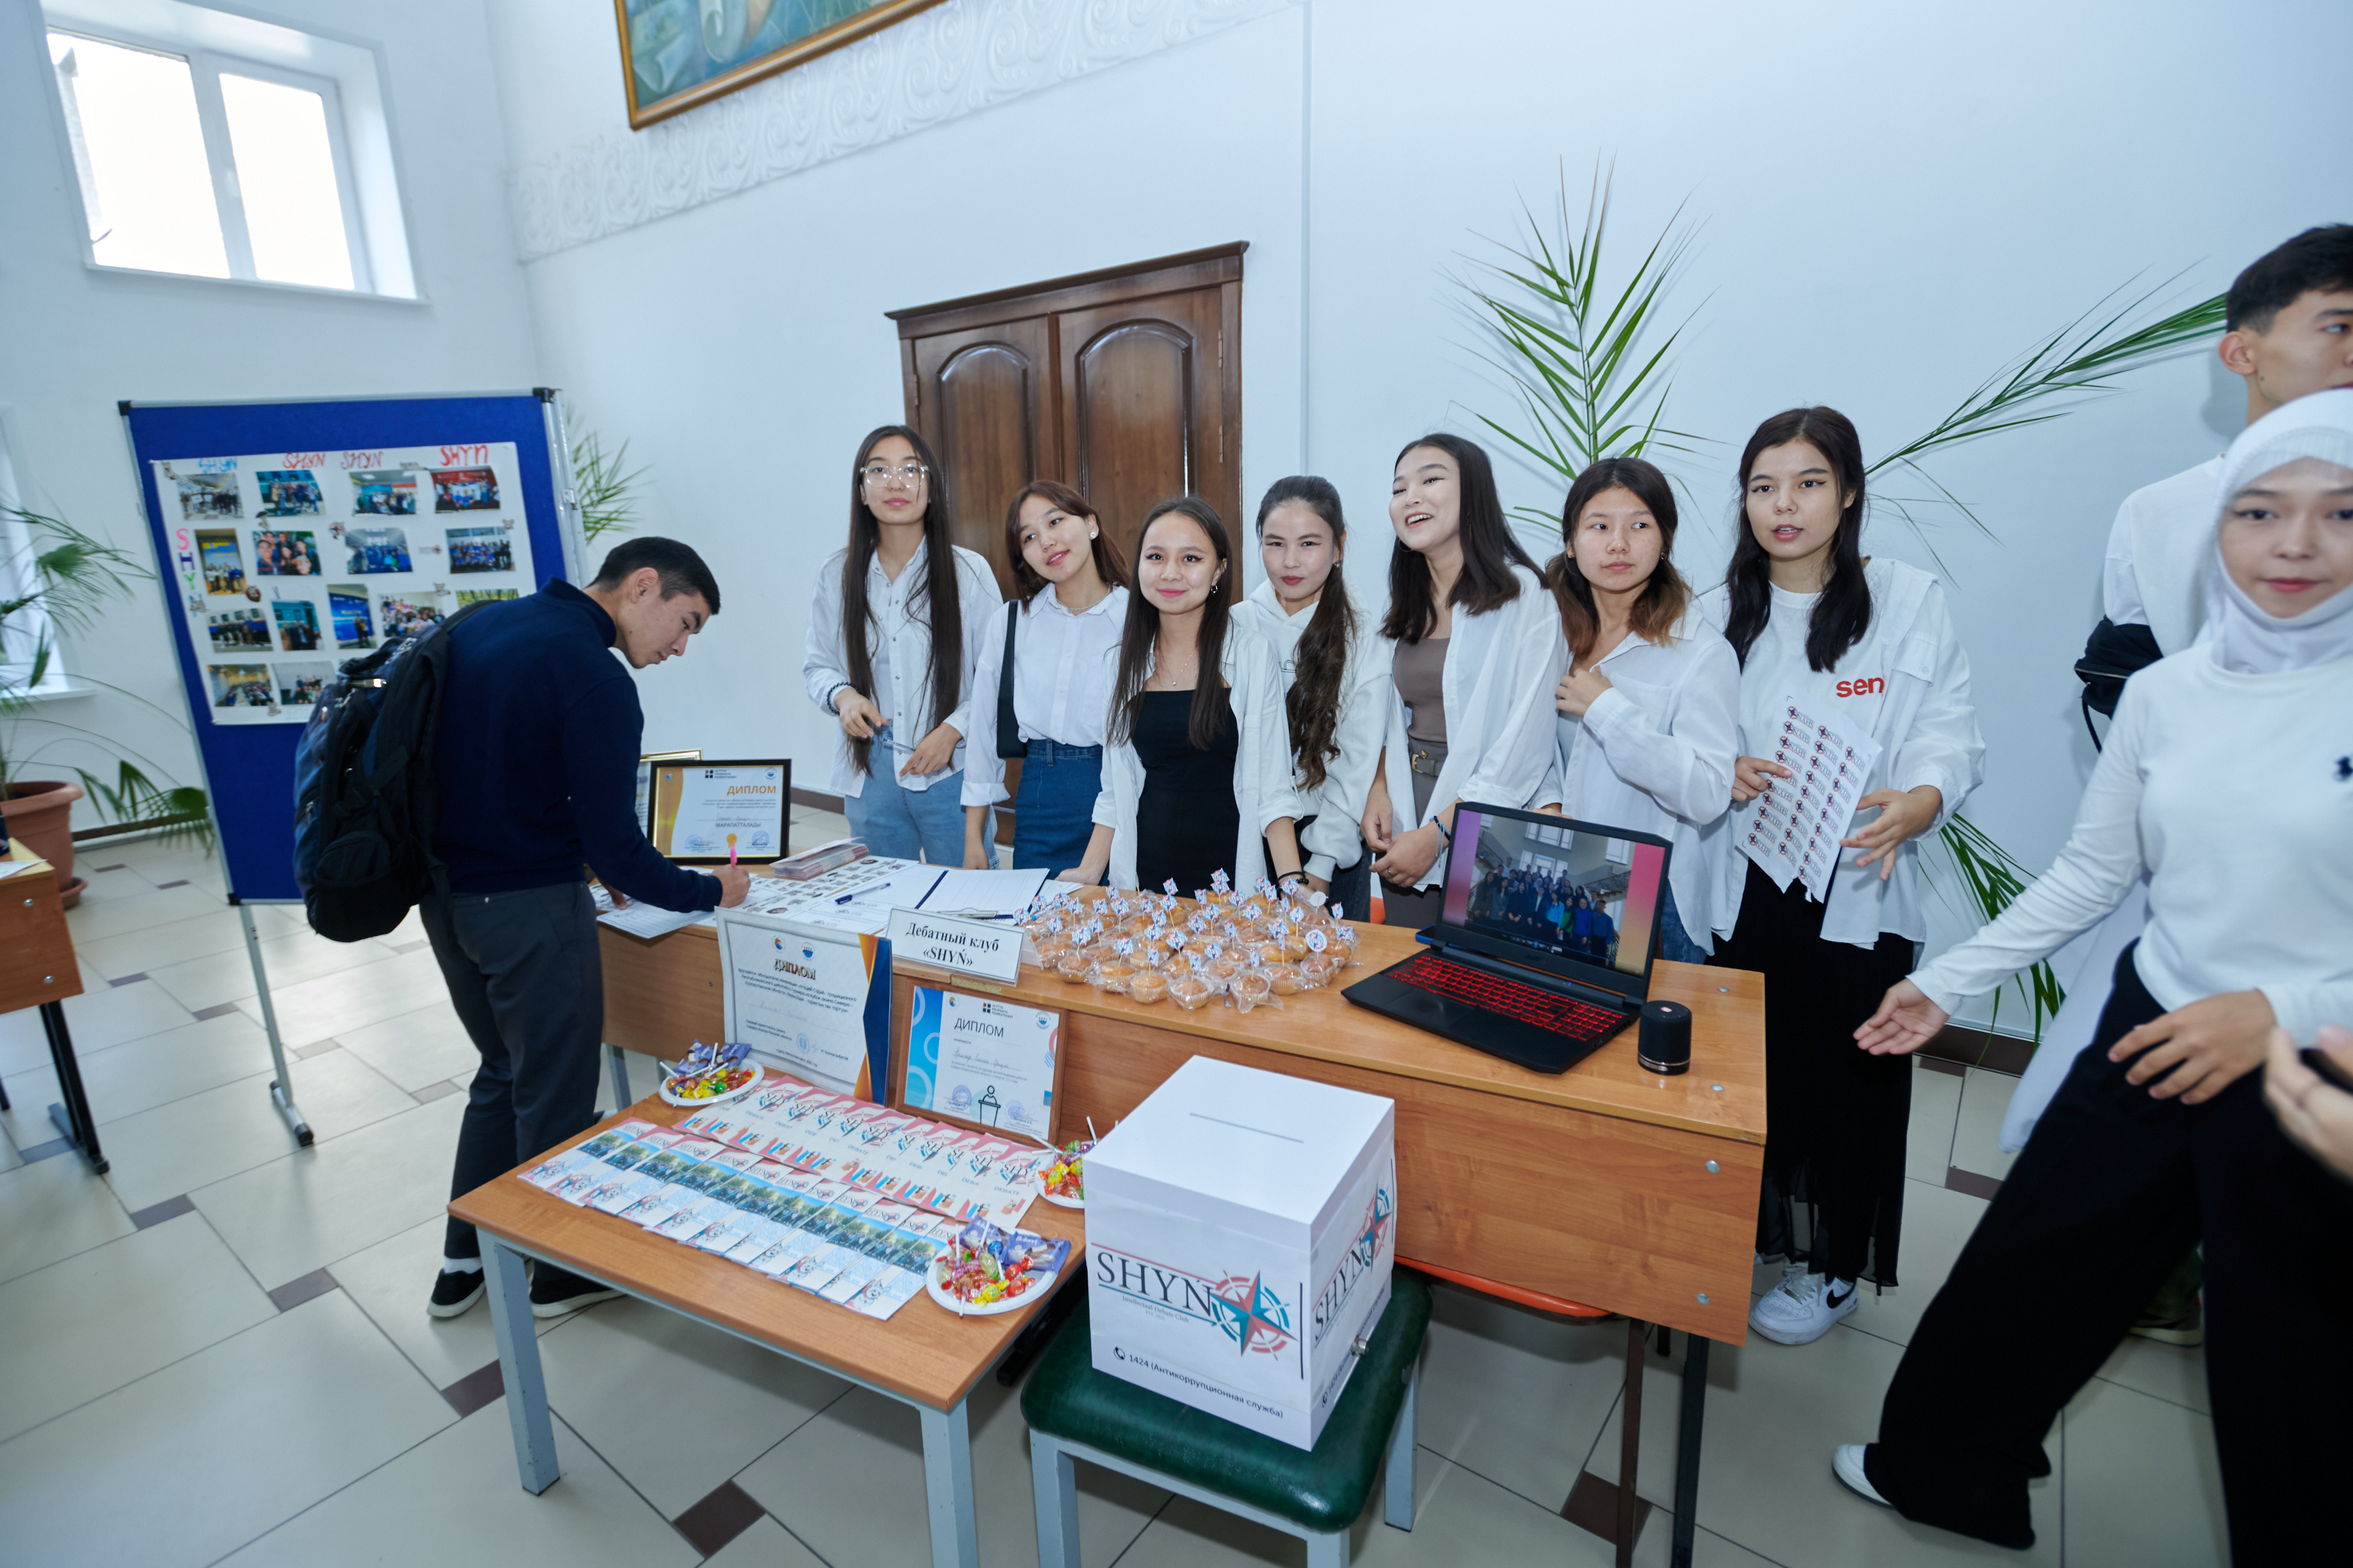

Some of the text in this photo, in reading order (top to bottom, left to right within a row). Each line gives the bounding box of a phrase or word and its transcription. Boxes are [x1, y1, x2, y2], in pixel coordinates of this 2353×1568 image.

[1836, 677, 1884, 697] sen
[727, 786, 776, 796] ДИПЛОМ
[906, 922, 999, 953] Дебатный клуб
[924, 946, 973, 967] «SHYŃ»
[773, 958, 816, 980] ДИПЛОМ
[954, 1017, 1004, 1038] ДИПЛОМ
[1154, 1306, 1173, 1318] Debate
[1175, 1313, 1189, 1323] Club
[1129, 1354, 1283, 1418] 1424 (Антикоррупционная служба)
